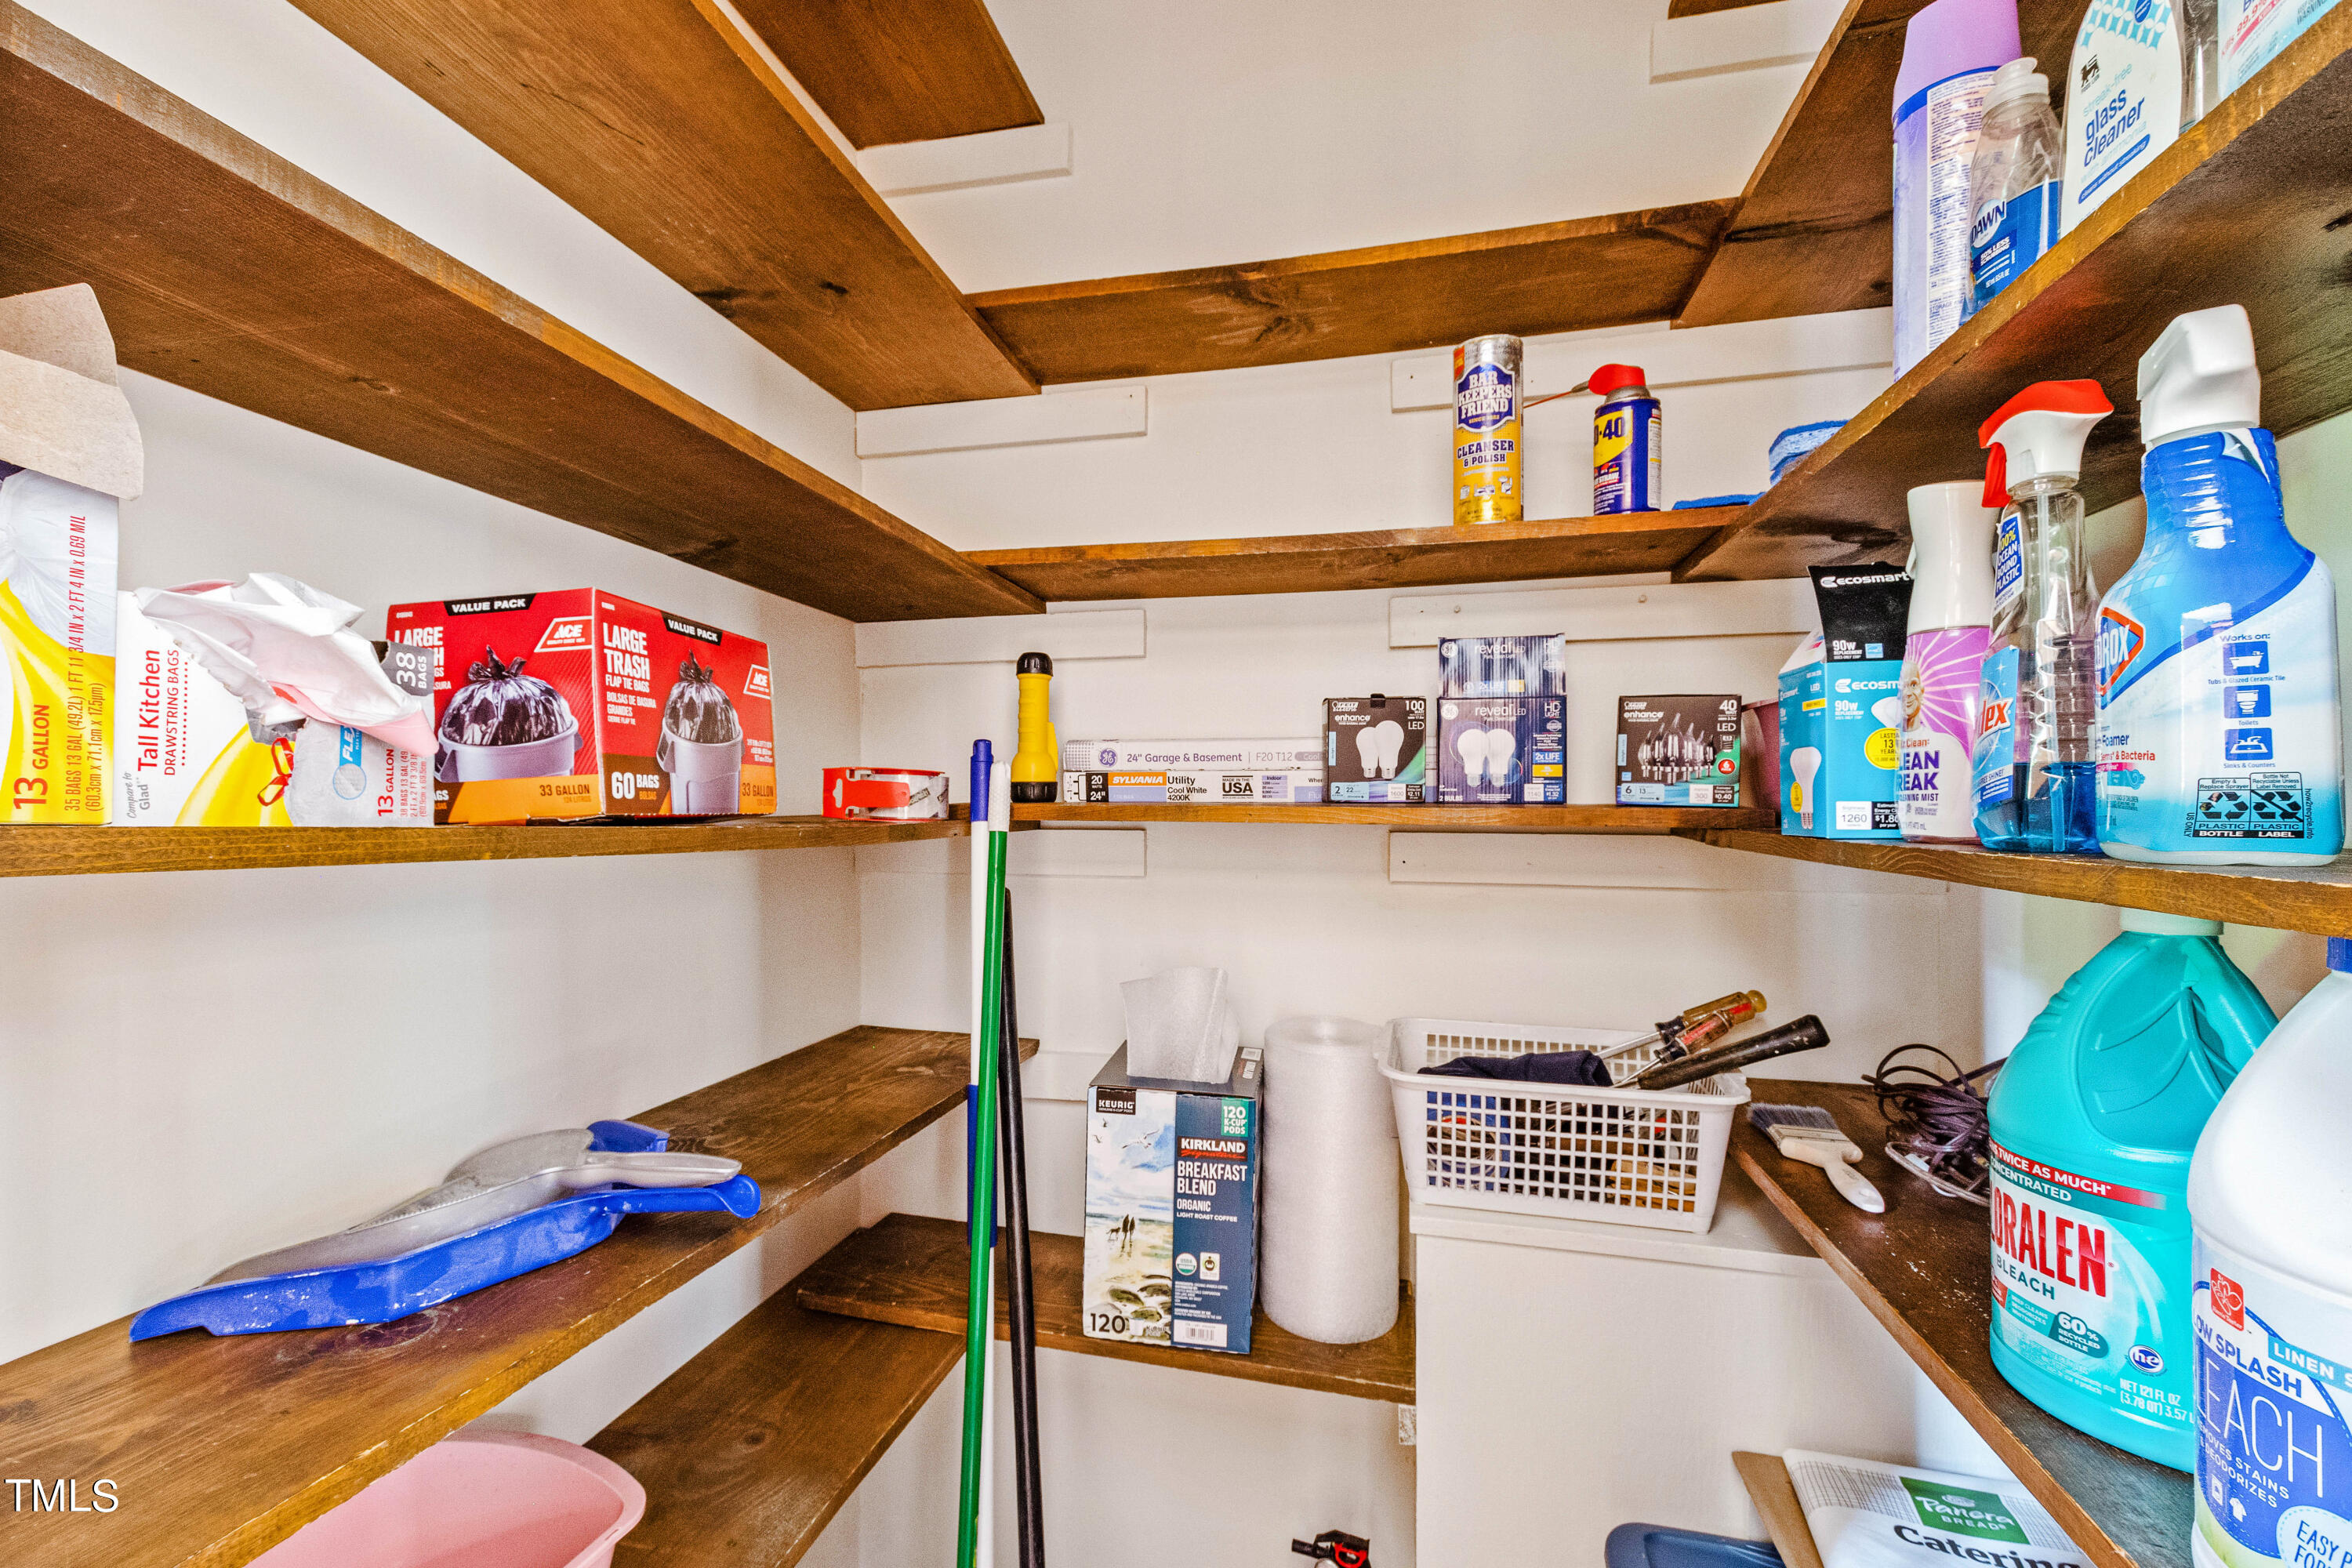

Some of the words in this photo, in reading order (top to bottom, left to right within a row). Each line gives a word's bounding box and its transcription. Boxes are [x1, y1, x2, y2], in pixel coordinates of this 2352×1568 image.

[2086, 89, 2127, 147] glass
[2084, 96, 2145, 168] cleaner
[1971, 201, 2005, 245] DAWN
[1469, 371, 1498, 389] BAR
[1458, 384, 1512, 407] KEEPERS
[1461, 398, 1509, 419] FRIEND
[1457, 440, 1514, 459] CLEANSER
[1472, 453, 1506, 465] POLISH
[70, 515, 85, 533] MIL
[69, 535, 85, 557] 0.69
[1998, 541, 2018, 566] OCEAN
[69, 567, 85, 579] IN
[1836, 572, 1910, 586] ecosmart
[1997, 564, 2020, 592] PLASTIC
[69, 590, 85, 603] FT
[452, 601, 490, 613] VALUE
[493, 598, 526, 609] PACK
[69, 622, 84, 633] IN
[394, 626, 444, 646] LARGE
[554, 624, 583, 639] ACE
[668, 619, 695, 635] VALUE
[696, 629, 718, 642] PACK
[69, 636, 84, 652] 3/4
[603, 622, 648, 655] LARGE
[1832, 640, 1857, 651] 90w
[2220, 633, 2252, 642] Works
[1475, 641, 1512, 654] reveal
[167, 649, 180, 684] BAGS
[396, 652, 416, 687] 38
[418, 655, 427, 689] BAGS
[604, 648, 650, 681] TRASH
[68, 671, 83, 683] FT
[605, 674, 623, 688] FLAP
[622, 677, 633, 690] TIE
[633, 679, 650, 693] BAGS
[139, 649, 161, 728] Kitchen
[67, 695, 86, 730] (49.2L)
[1405, 700, 1425, 711] 100
[1475, 703, 1513, 716] reveal
[1544, 702, 1560, 712] HD
[1719, 700, 1737, 711] 40
[1835, 700, 1858, 711] 90w
[165, 688, 180, 775] DRAWSTRING
[1408, 721, 1425, 730] LED
[1717, 723, 1737, 731] LED
[67, 734, 82, 751] GAL
[87, 734, 103, 761] 71.1cm
[1883, 739, 1893, 749] 13
[1906, 739, 1928, 748] Clean
[2102, 734, 2129, 746] Foamer
[13, 777, 48, 810] 13
[32, 704, 49, 770] GALLON
[67, 753, 82, 766] 13
[138, 735, 159, 771] Tall
[1127, 753, 1142, 763] 24"
[1145, 753, 1181, 764] Garage
[1183, 753, 1191, 762] &
[1193, 752, 1243, 763] Basement
[1256, 752, 1273, 761] F20
[1276, 752, 1293, 761] T12
[1544, 752, 1560, 760] LIFE
[2121, 750, 2156, 761] Bacteria
[66, 771, 82, 797] BAGS
[378, 795, 394, 817] 13
[386, 749, 394, 793] GALLON
[611, 771, 635, 799] 60
[636, 775, 660, 789] BAGS
[1091, 775, 1103, 785] 20
[1112, 775, 1163, 784] SYLVANIA
[1167, 775, 1196, 786] Utility
[1222, 782, 1254, 793] USA
[1896, 772, 1939, 791] REAK
[85, 777, 104, 811] (60.3cm
[140, 784, 150, 811] Glad
[539, 784, 553, 796] 33
[555, 784, 590, 796] GALLON
[742, 782, 750, 797] 33
[751, 784, 774, 797] GALLON
[1091, 790, 1105, 800] 24"
[1167, 786, 1181, 795] Cool
[1182, 786, 1207, 795] White
[1625, 785, 1632, 794] 6
[65, 798, 80, 811] 35
[127, 782, 136, 818] Compare
[1842, 814, 1867, 822] 1260
[2183, 821, 2194, 837] ONLY
[1098, 1099, 1134, 1109] KEURIG
[1223, 1105, 1246, 1119] 120
[1224, 1126, 1246, 1135] PODS
[1181, 1138, 1245, 1153] KIRKLAND
[1181, 1149, 1246, 1160] Signature
[1177, 1160, 1247, 1181] BREAKFAST
[1998, 1147, 2030, 1172] TWICE
[2032, 1164, 2051, 1179] AS
[1177, 1178, 1217, 1196] BLEND
[1991, 1156, 2072, 1202] CONCENTRATED
[1177, 1198, 1211, 1212] ORGANIC
[1996, 1254, 2055, 1301] BLEACH
[1091, 1312, 1126, 1334] 120
[2058, 1327, 2100, 1349] RECYCLED
[2058, 1335, 2089, 1352] BOTTLE
[2133, 1348, 2160, 1369] he
[2195, 1314, 2213, 1343] OW
[2216, 1334, 2302, 1399] SPLASH
[2274, 1342, 2335, 1381] LINEN
[2119, 1377, 2138, 1394] NET
[2154, 1388, 2166, 1403] FL
[2120, 1390, 2146, 1410] (3.78
[2165, 1405, 2188, 1421] 3.57
[2205, 1356, 2323, 1498] EACH
[2205, 1442, 2278, 1508] DEODORIZES
[2235, 1457, 2290, 1500] STAINS
[1915, 1496, 2016, 1526] Panera
[1940, 1515, 2002, 1530] BREAD
[2296, 1519, 2339, 1562] EASY
